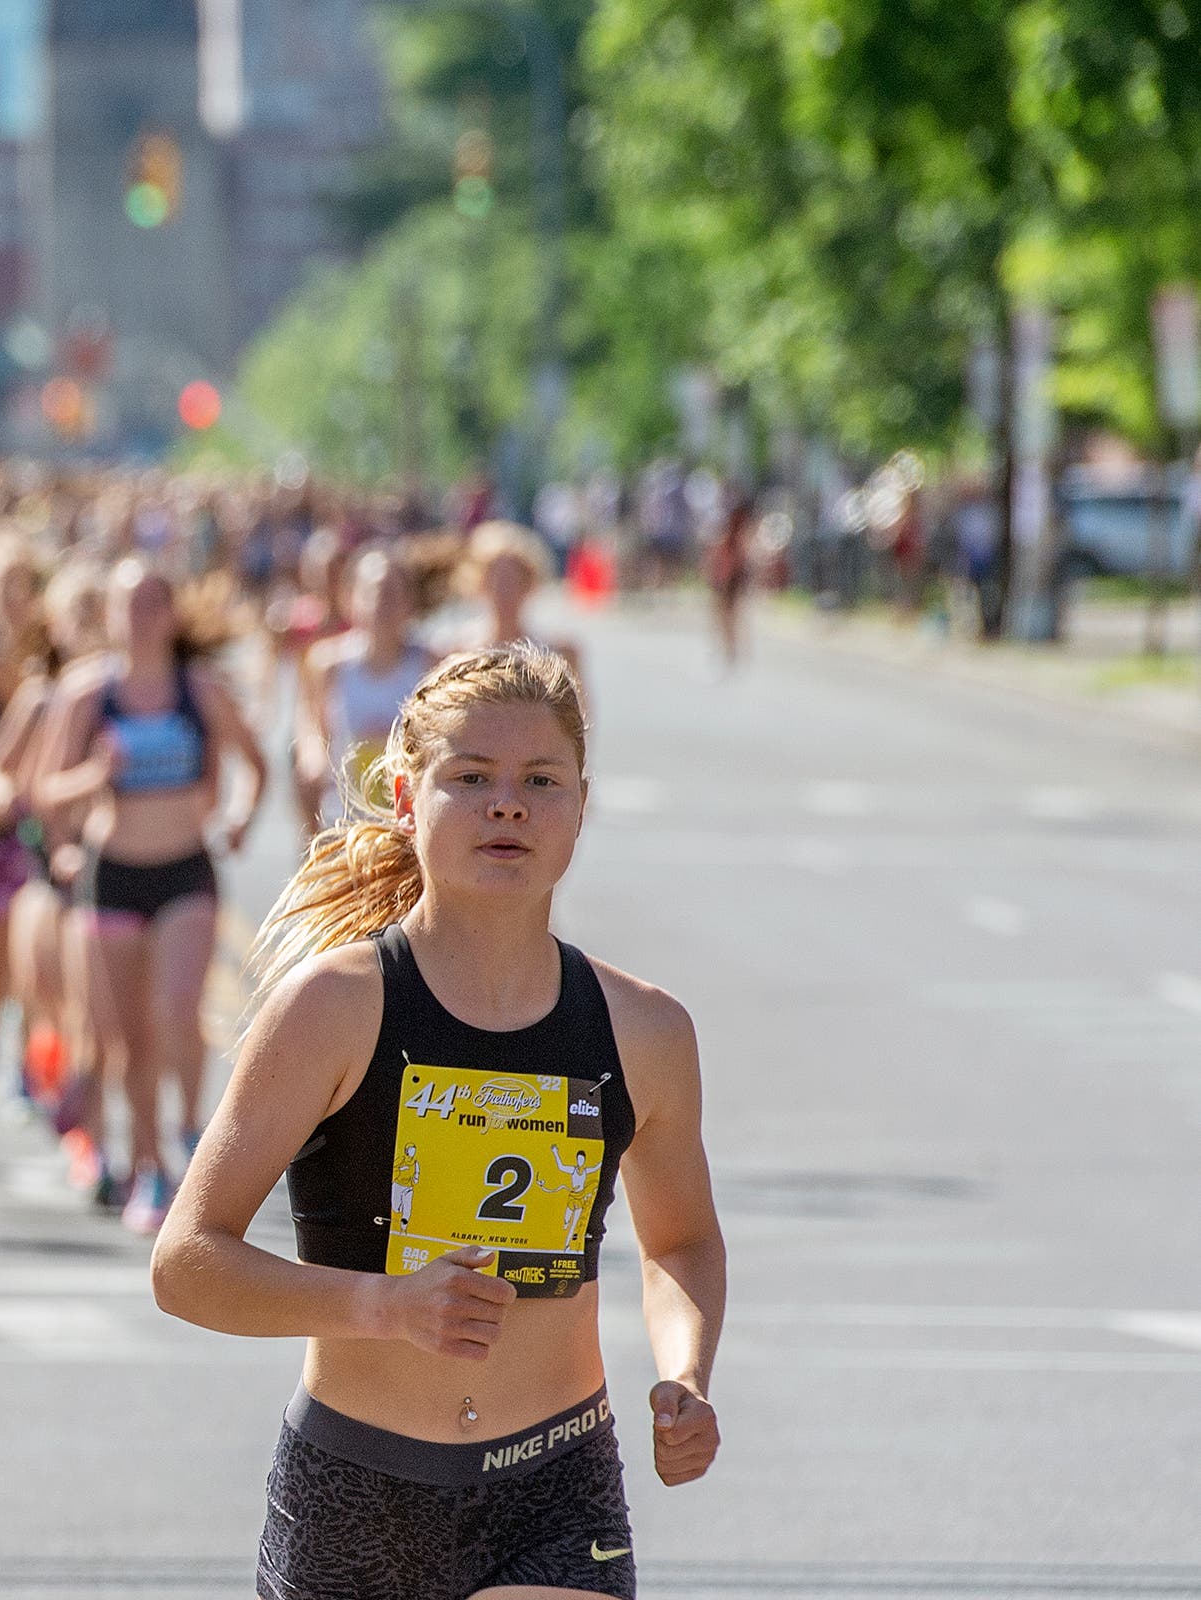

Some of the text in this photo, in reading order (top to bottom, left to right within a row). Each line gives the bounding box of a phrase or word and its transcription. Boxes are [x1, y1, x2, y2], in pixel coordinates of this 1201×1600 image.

[569, 1100, 599, 1117] elite
[475, 1154, 535, 1223] 2
[450, 1231, 529, 1245] ALBANY, NEW YORK
[552, 1260, 577, 1269] 1 FREE
[482, 1434, 544, 1472] NIKE
[547, 1408, 596, 1450] PRO
